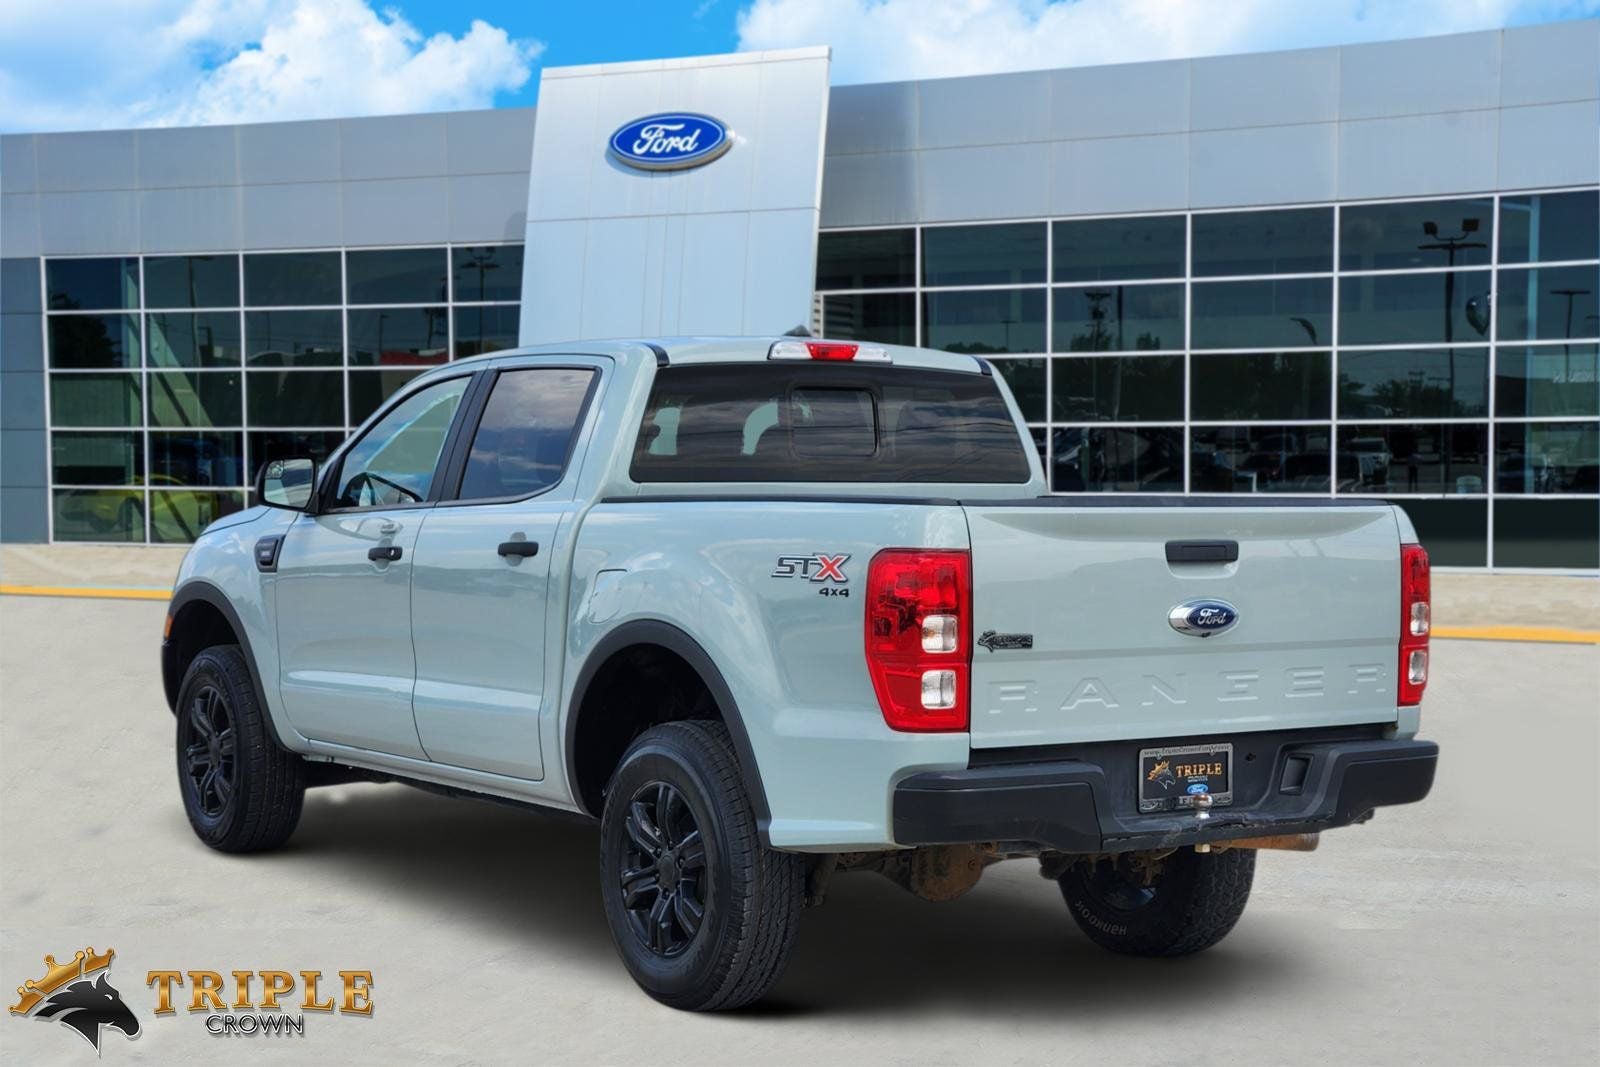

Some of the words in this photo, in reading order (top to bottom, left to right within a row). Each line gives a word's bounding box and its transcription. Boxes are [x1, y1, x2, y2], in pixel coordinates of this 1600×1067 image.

[632, 123, 701, 155] Ford
[771, 552, 851, 583] STX
[1197, 608, 1227, 625] Ford
[988, 663, 1388, 715] RANGER
[1175, 762, 1223, 778] TRIPLE
